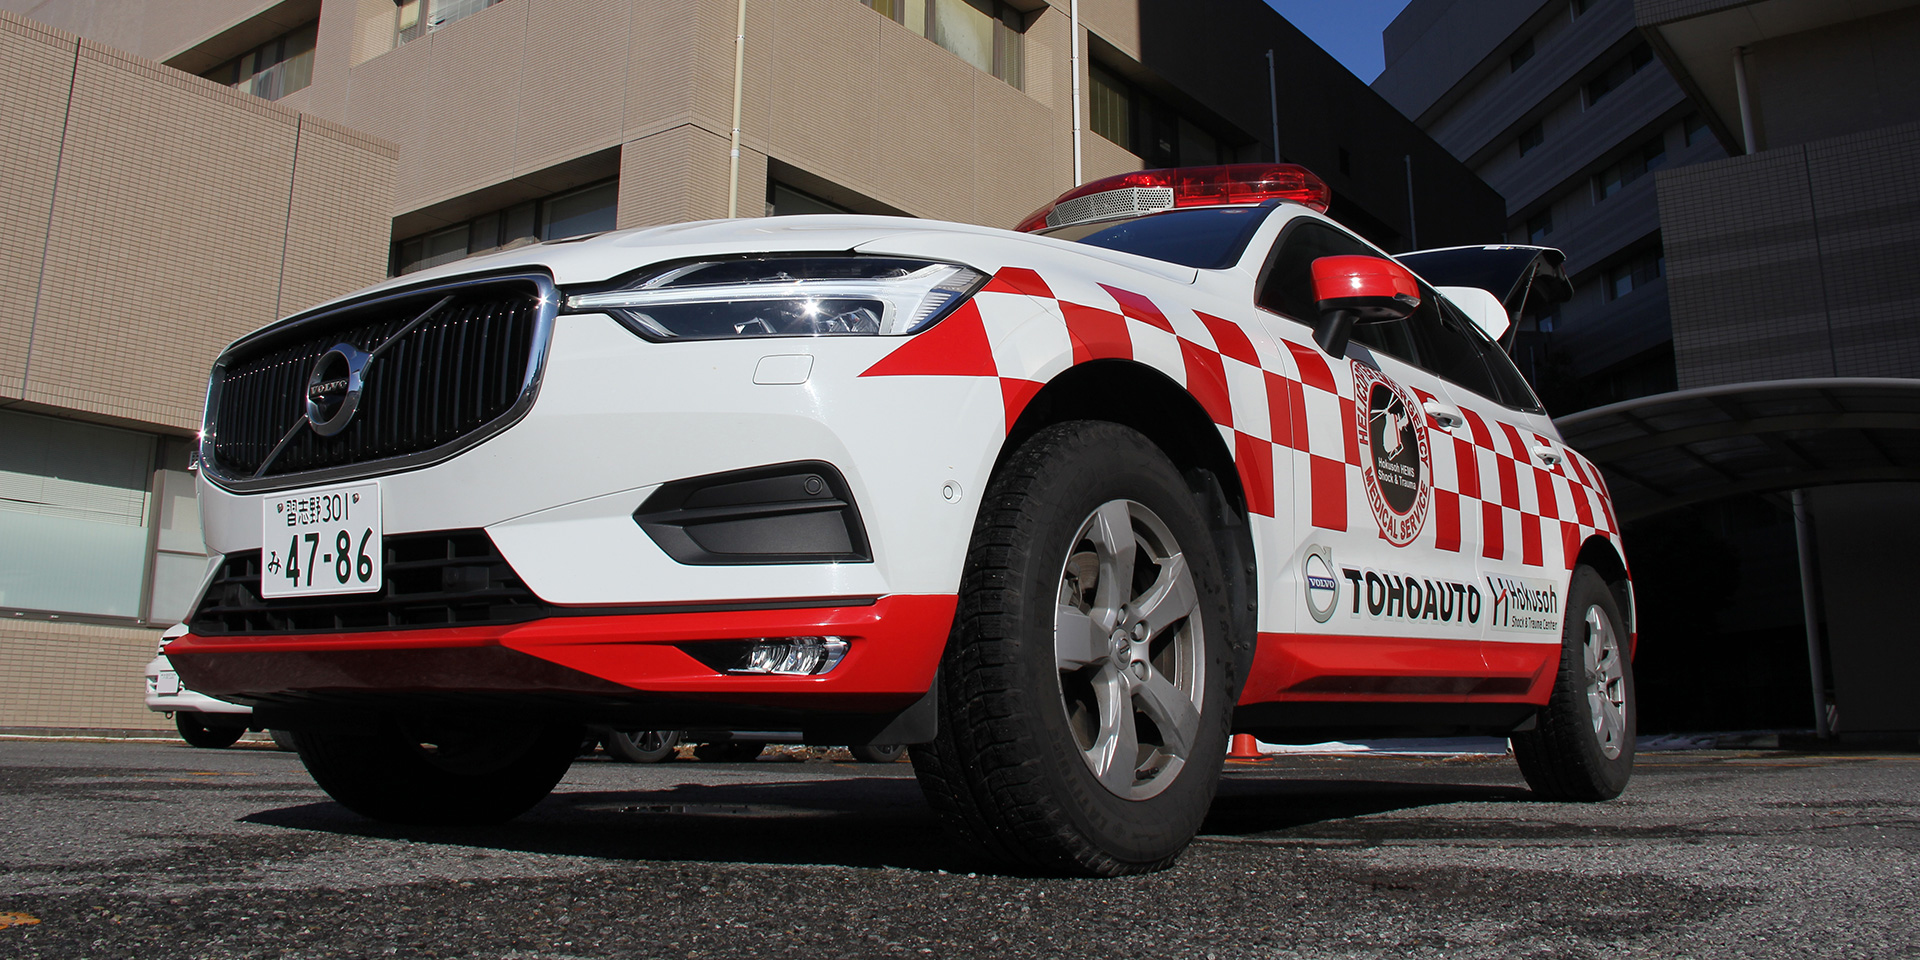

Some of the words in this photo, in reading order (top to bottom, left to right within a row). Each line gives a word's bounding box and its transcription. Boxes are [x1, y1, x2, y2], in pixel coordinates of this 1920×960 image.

[310, 379, 348, 395] VOLVO
[1374, 370, 1429, 469] EMERGENCY
[1377, 469, 1394, 484] Shock
[1399, 475, 1417, 490] Trauma
[1364, 466, 1398, 539] MEDICAL
[1400, 479, 1429, 540] SERVICE
[285, 527, 373, 588] 47-86
[1308, 577, 1335, 589] VOLVO
[1341, 567, 1481, 624] TOHOAUTO
[1505, 579, 1558, 614] Hokusoh
[1511, 615, 1525, 628] Shock
[1528, 616, 1543, 630] Trauma
[1543, 618, 1558, 631] Center
